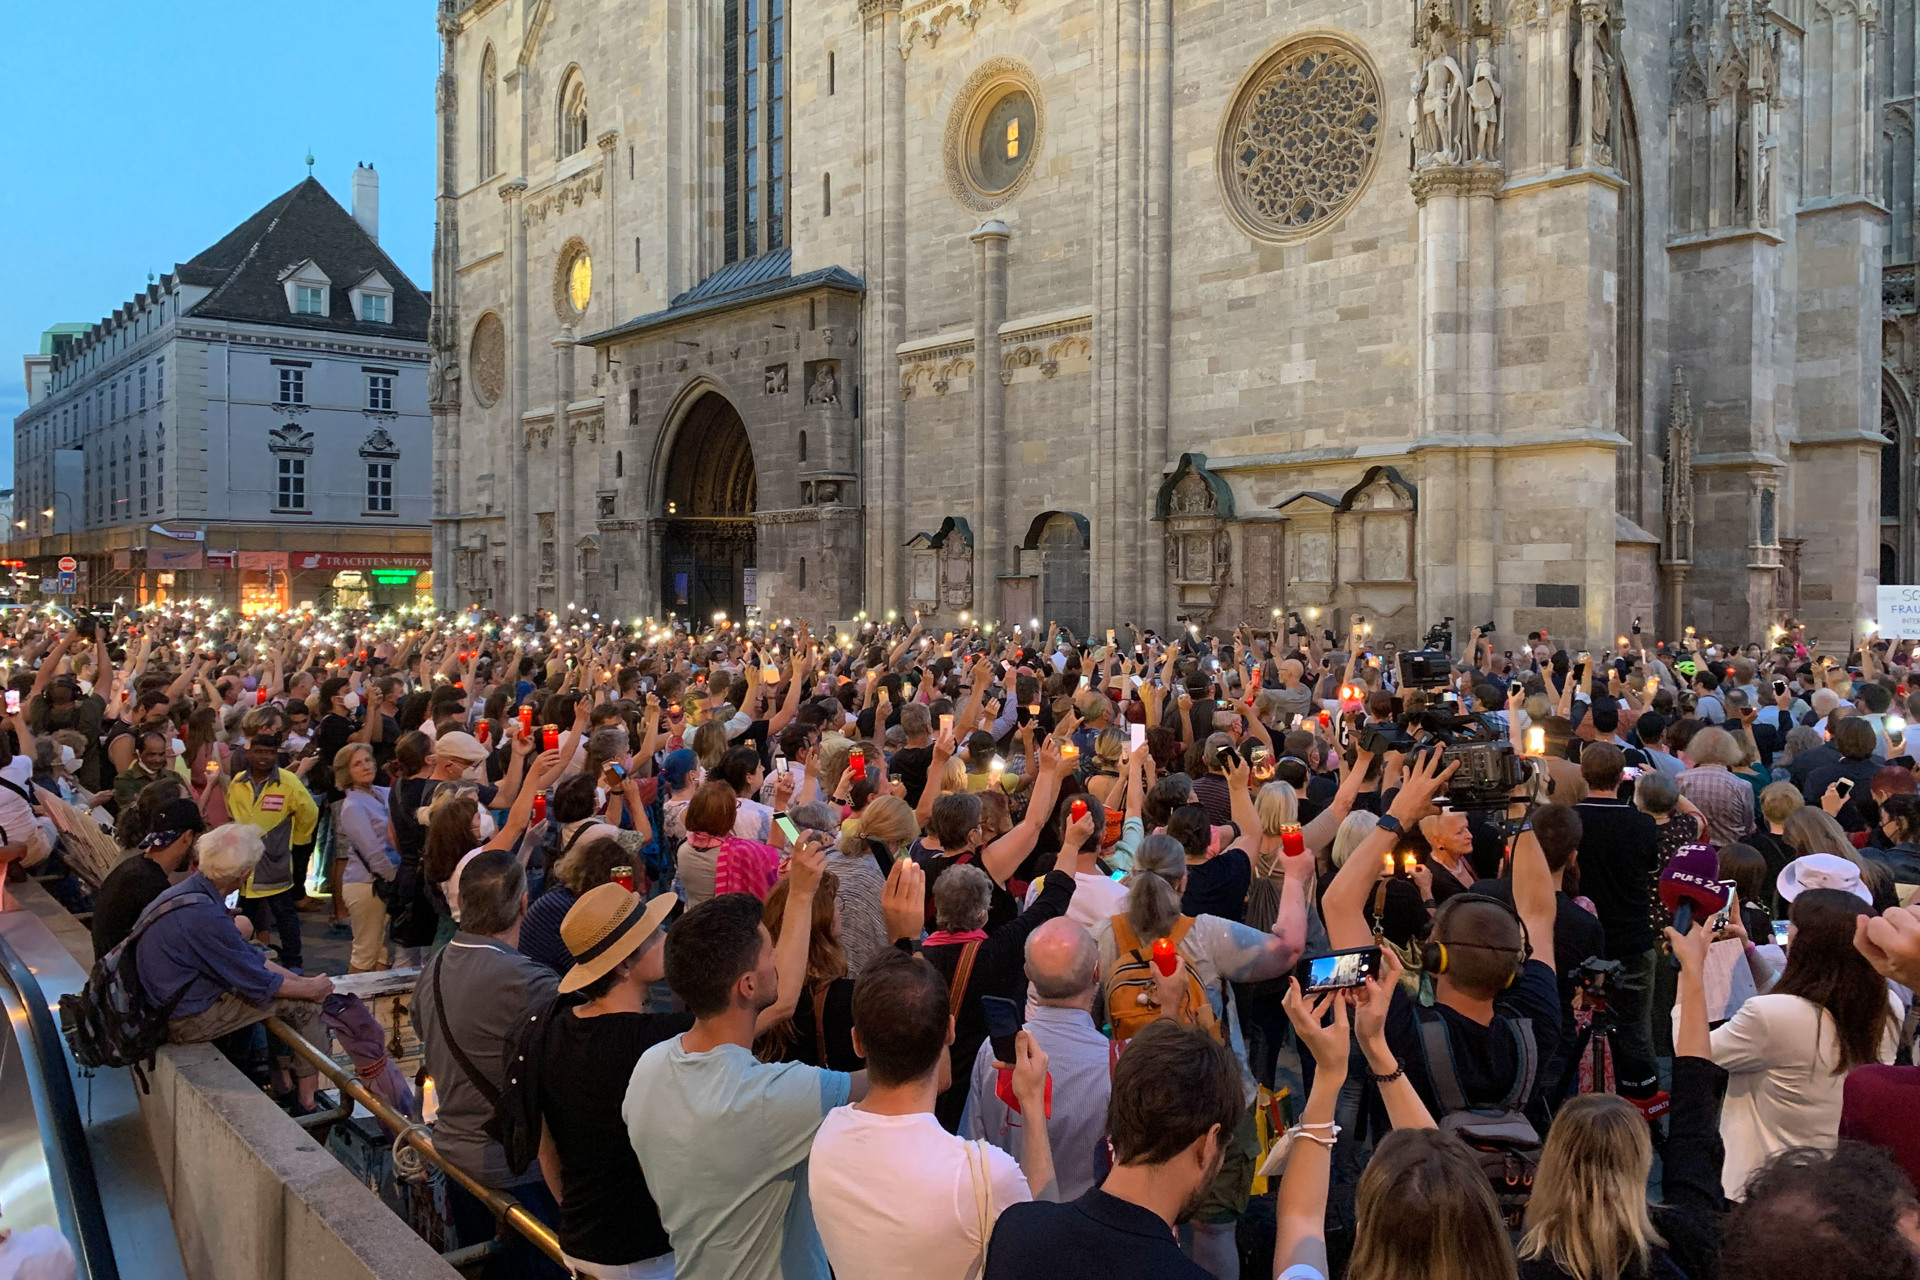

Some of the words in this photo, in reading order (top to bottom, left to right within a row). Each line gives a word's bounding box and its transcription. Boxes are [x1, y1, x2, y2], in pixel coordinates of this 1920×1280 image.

[326, 556, 432, 567] TRACHTEN-WITZK
[1902, 588, 1920, 602] SC
[1677, 844, 1707, 852] PULS
[1671, 871, 1704, 885] PULS
[1704, 880, 1722, 894] 24
